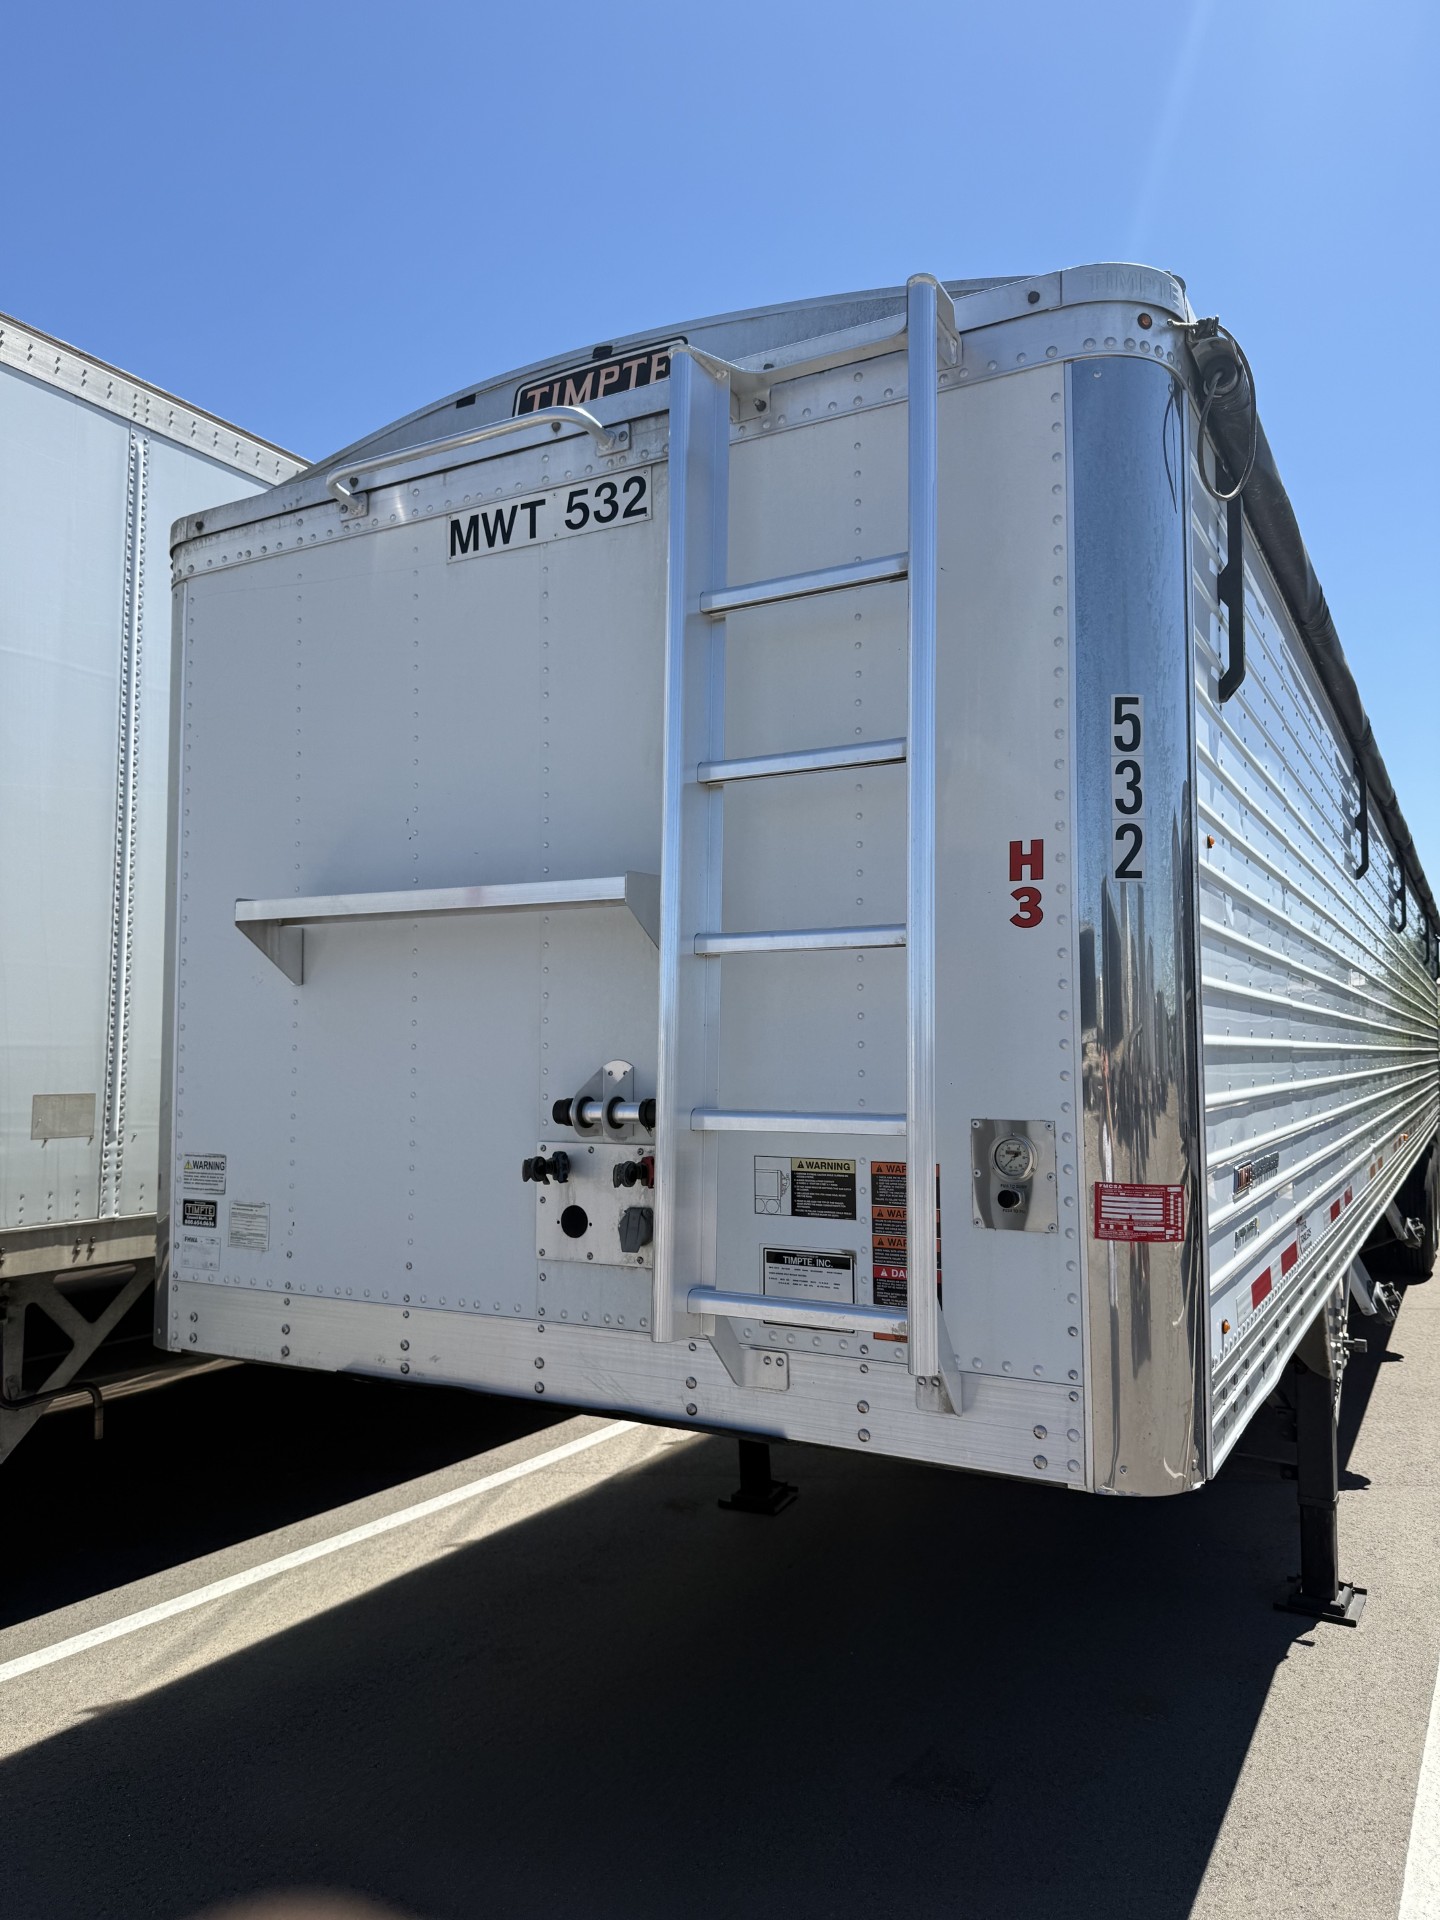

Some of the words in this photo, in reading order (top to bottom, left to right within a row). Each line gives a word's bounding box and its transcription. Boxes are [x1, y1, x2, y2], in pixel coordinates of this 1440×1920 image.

[450, 498, 546, 557] MWT
[565, 475, 648, 531] 532
[1113, 696, 1143, 879] 532
[192, 1160, 225, 1171] WARNING
[805, 1161, 851, 1171] WARNING
[187, 1205, 214, 1215] TIMPTE
[816, 1258, 834, 1268] INC.
